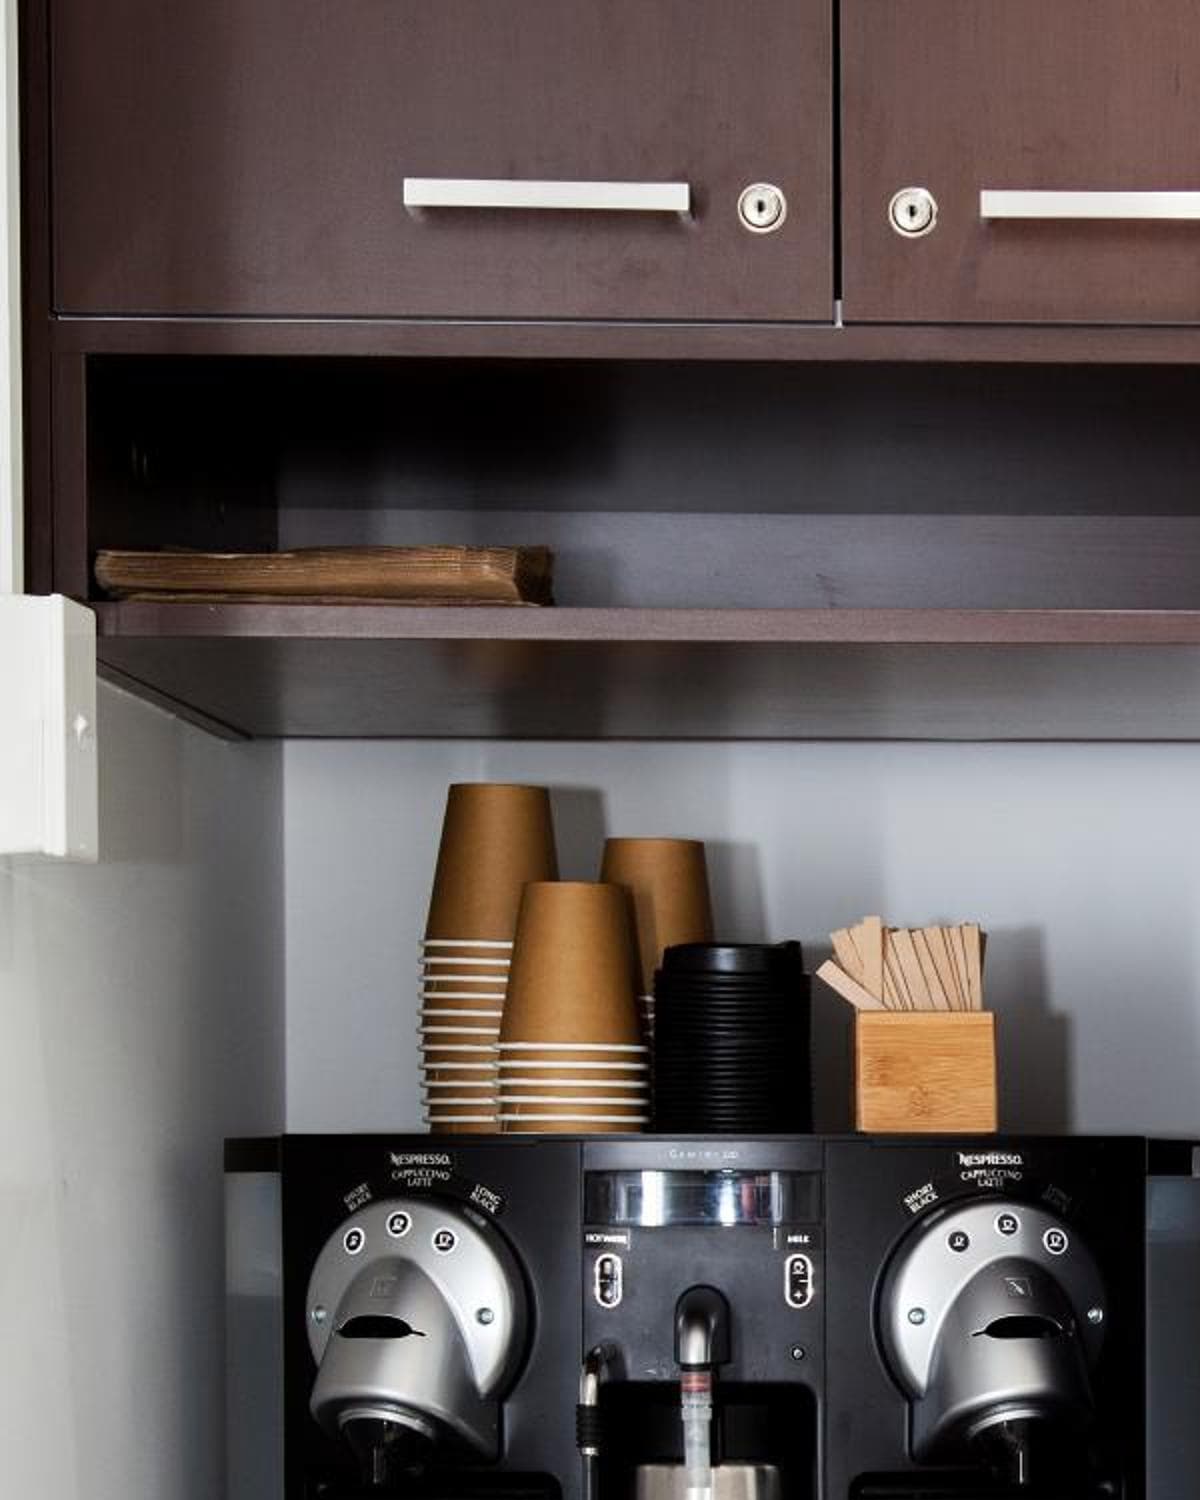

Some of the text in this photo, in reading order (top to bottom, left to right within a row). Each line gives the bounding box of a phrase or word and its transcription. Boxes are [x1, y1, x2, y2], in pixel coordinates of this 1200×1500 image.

[391, 1169, 450, 1181] CAPPUCCINO
[407, 1178, 433, 1187] LATTE
[960, 1169, 1023, 1181] CAPPUCCINO
[470, 1191, 497, 1214] BLACK
[474, 1183, 501, 1206] LONG
[904, 1183, 934, 1204] SHORT
[909, 1192, 939, 1213] BLACK
